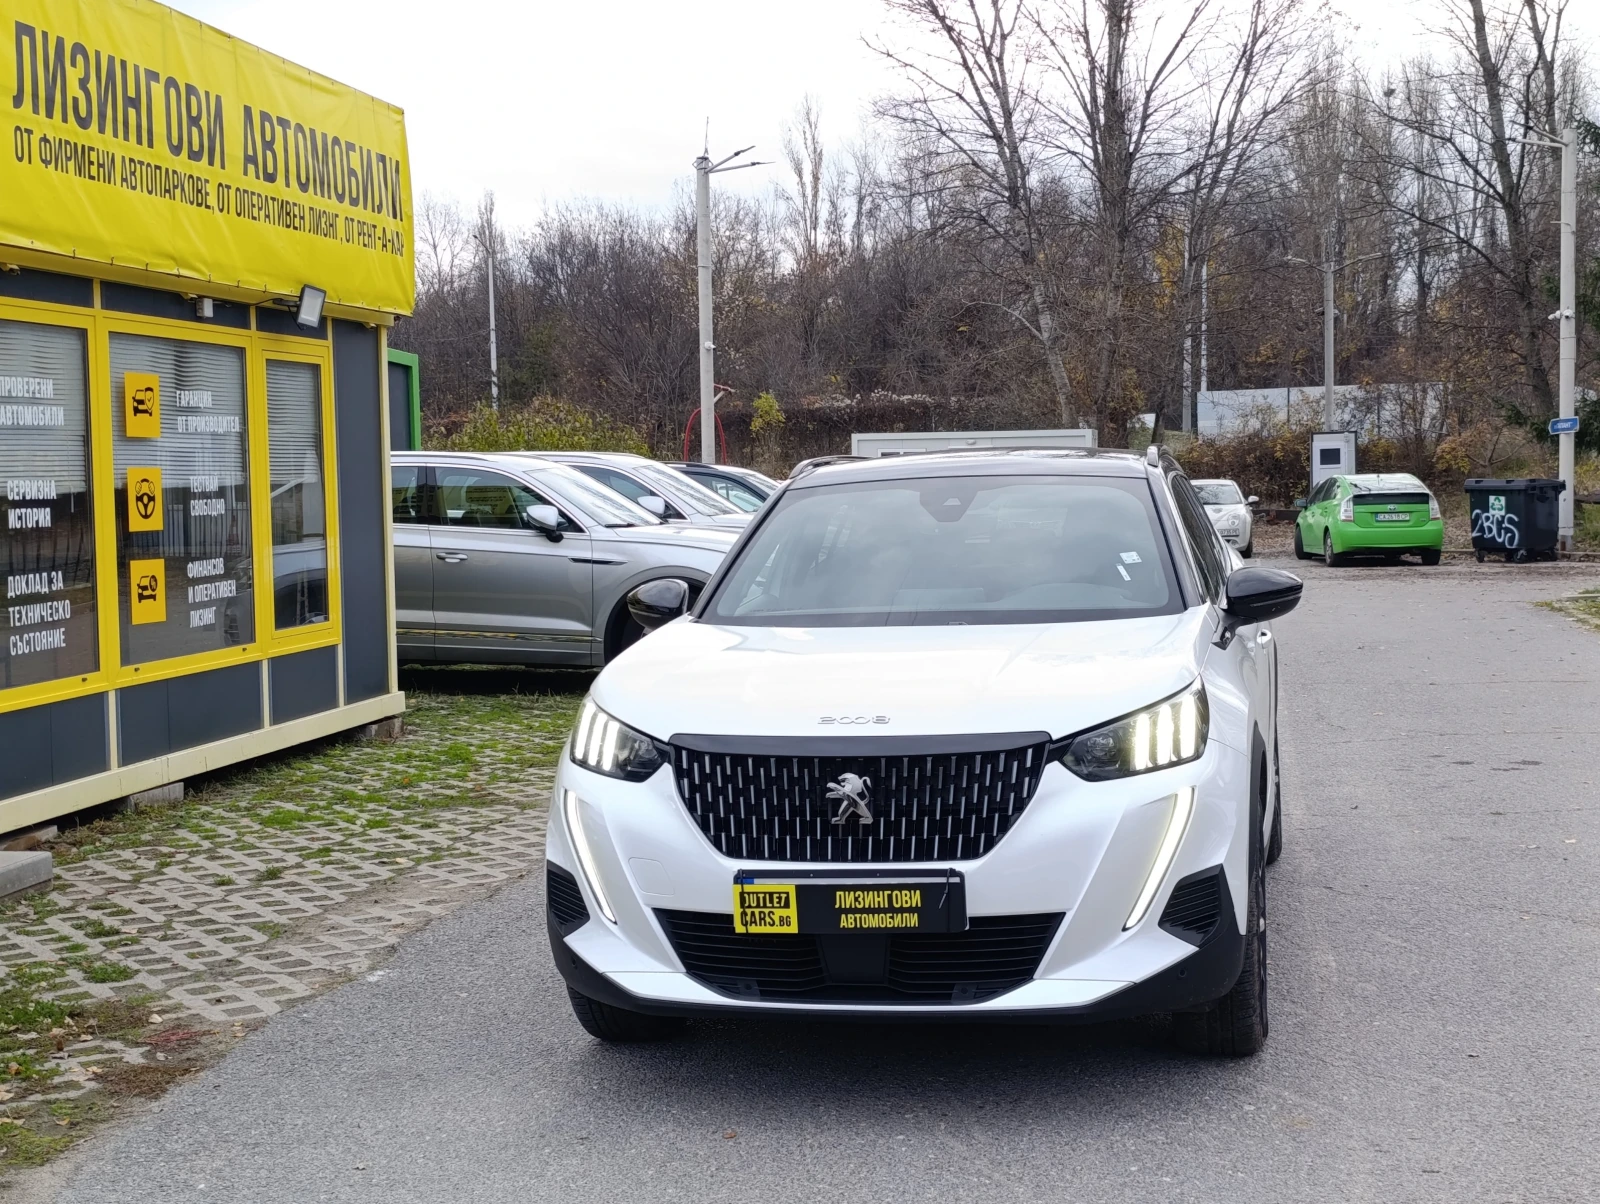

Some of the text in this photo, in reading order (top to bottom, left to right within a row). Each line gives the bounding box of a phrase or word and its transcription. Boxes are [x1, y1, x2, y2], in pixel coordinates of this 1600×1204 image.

[12, 20, 404, 222] ЛИЗИНГОВИ АВТОМОБИЛИ
[14, 125, 34, 165] ОТ
[38, 133, 117, 186] ФИРМЕНИ
[120, 155, 215, 215] АВТОПАРКОВЕ,
[217, 182, 232, 215] ОТ
[235, 186, 306, 232] ОПЕРАТИВЕН
[344, 216, 355, 244] ОТ
[176, 390, 212, 409] ГАРАНЦИЯ
[0, 405, 64, 426] АВТОМОБИЛИ
[178, 415, 240, 434] ОТ ПРОИЗВОДИТЕЛ
[7, 480, 57, 500] СЕРВИЗНА
[190, 473, 219, 492] ТЕСТВАЙ
[8, 507, 51, 529] ИСТОРИЯ
[190, 498, 225, 517] СВОБОДНО
[187, 558, 224, 579] ФИНАНСОВ
[7, 571, 64, 599] ДОКЛАД ЗА
[188, 580, 237, 604] И ОПЕРАТИВЕН
[8, 599, 71, 627] ТЕХНИЧЕСКО
[190, 606, 216, 628] ЛИЗИНГ
[10, 627, 66, 656] СЪСТОЯНИЕ
[817, 716, 891, 724] 2008
[835, 890, 921, 909] ЛИЗИНГОВИ
[740, 910, 792, 927] CARS.BG
[840, 913, 919, 928] АВТОМОБИЛИ
